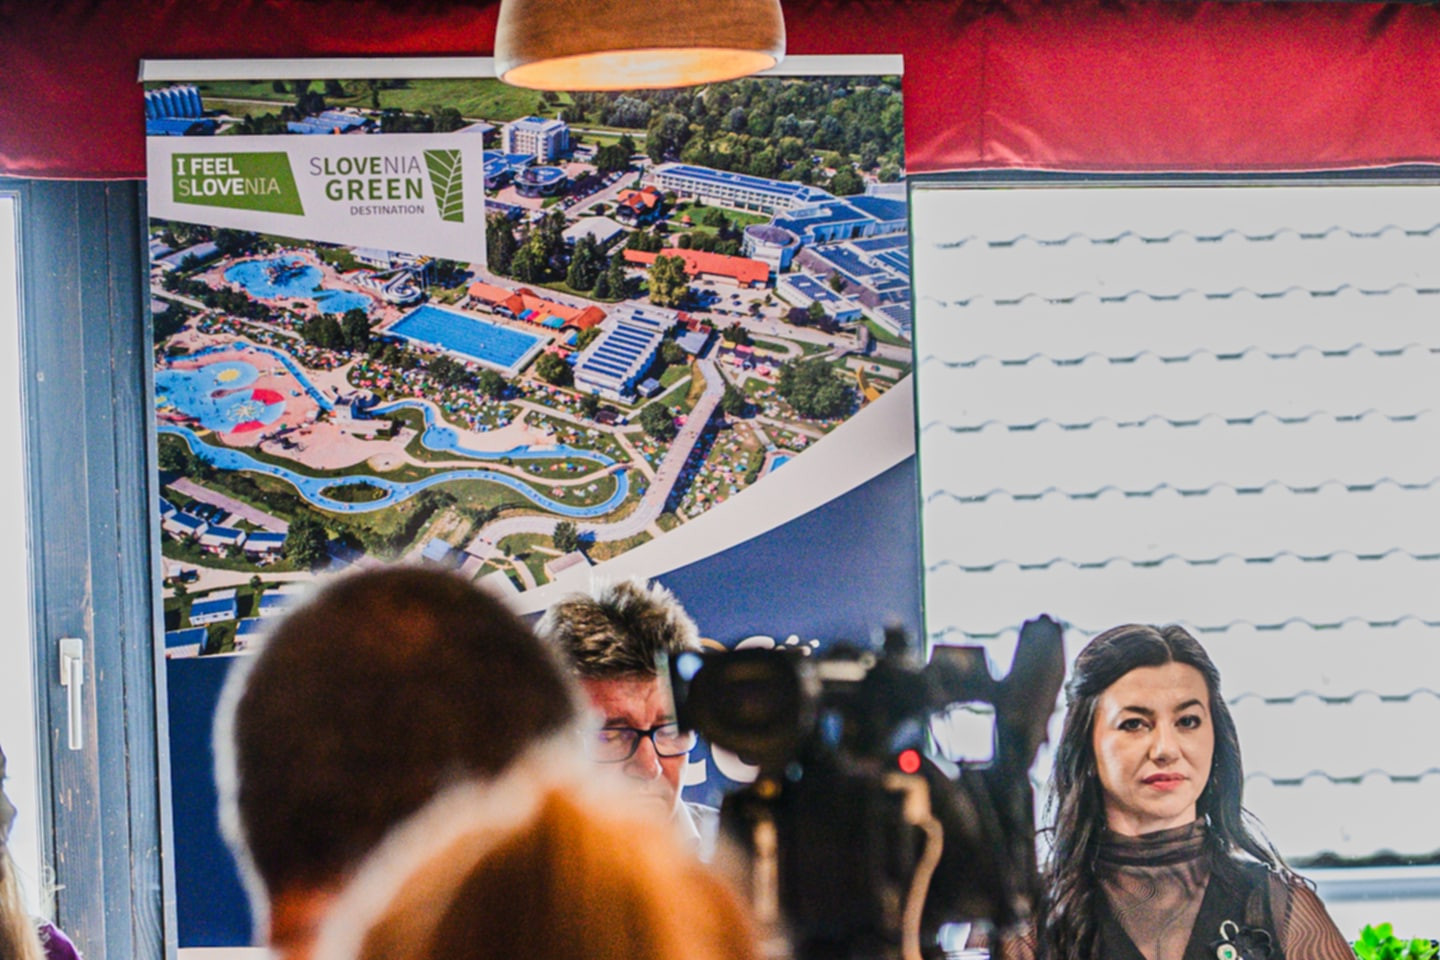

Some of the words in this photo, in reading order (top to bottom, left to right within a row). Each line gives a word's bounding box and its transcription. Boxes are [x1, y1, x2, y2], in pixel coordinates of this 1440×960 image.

[176, 157, 186, 176] I
[190, 157, 240, 176] FEEL
[309, 155, 422, 177] SLOVENIA
[178, 176, 281, 196] SLOVENIA
[325, 177, 424, 201] GREEN
[349, 204, 425, 216] DESTINATION
